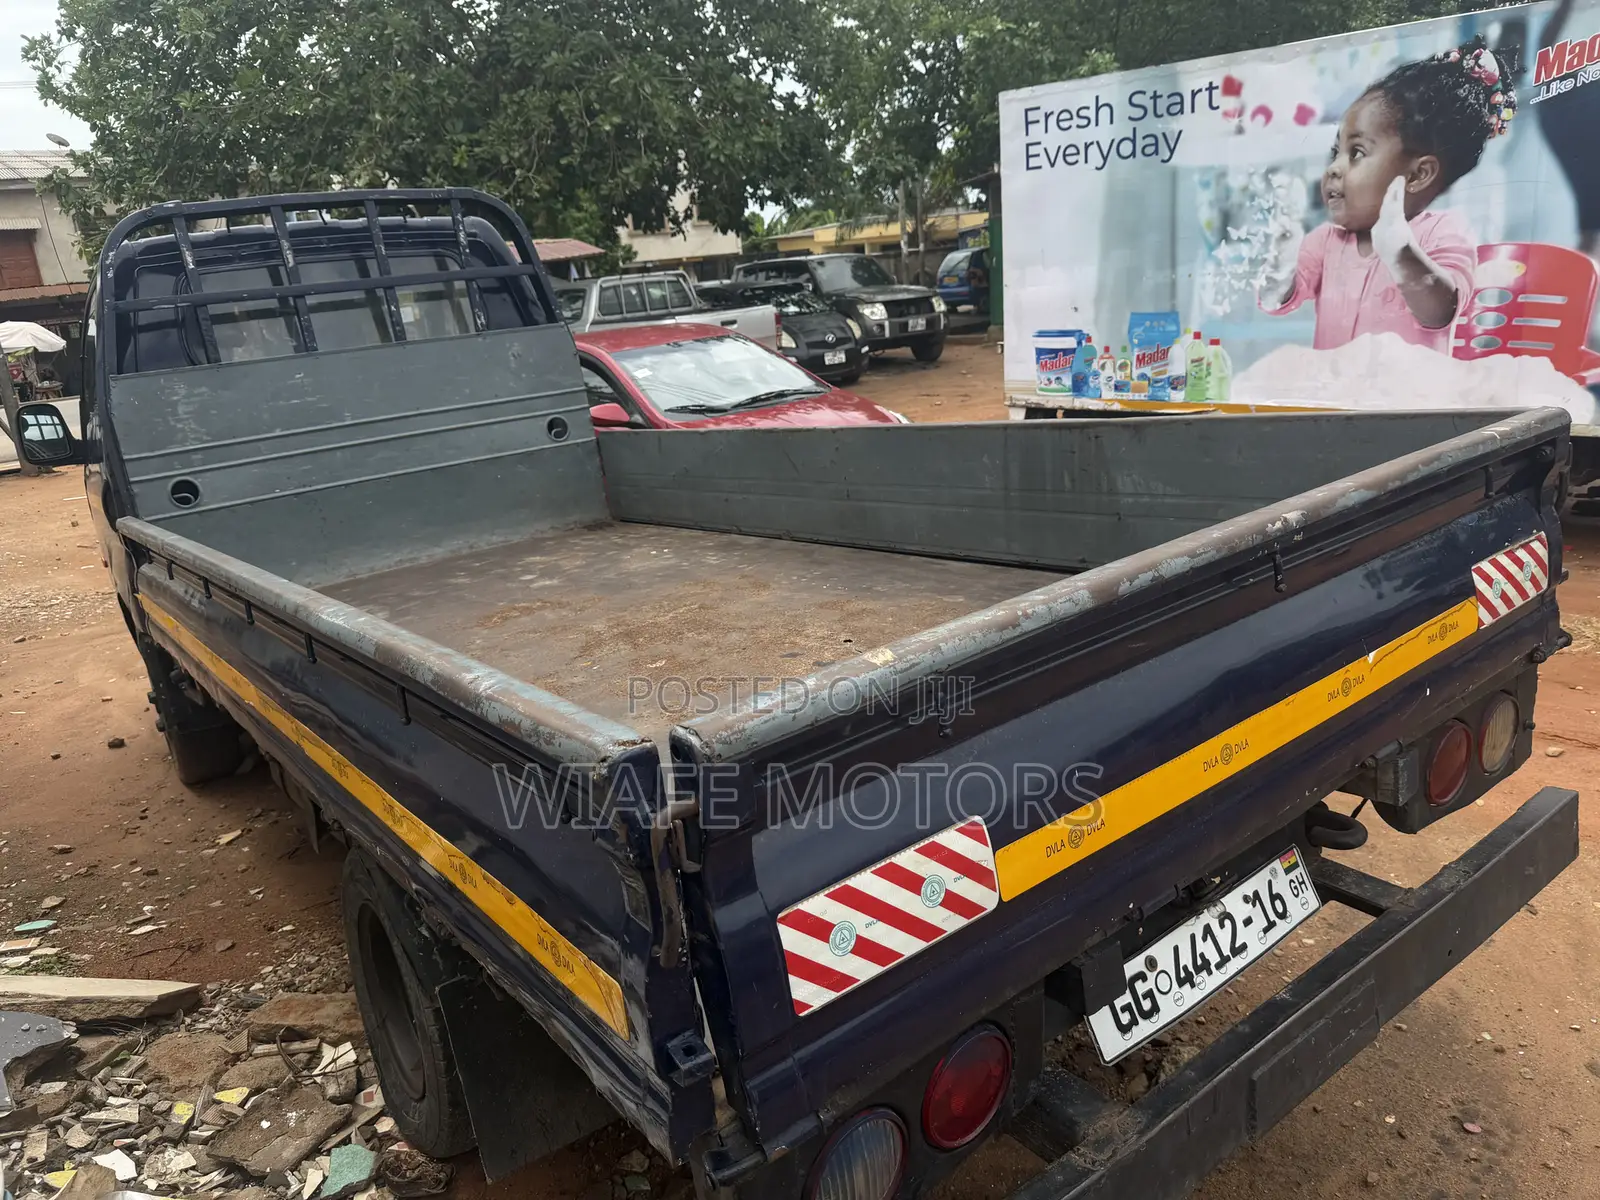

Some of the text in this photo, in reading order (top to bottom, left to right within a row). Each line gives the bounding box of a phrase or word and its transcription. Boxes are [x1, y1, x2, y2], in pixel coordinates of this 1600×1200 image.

[1024, 81, 1220, 137] Fresh Start
[1025, 127, 1183, 171] Everyday
[1040, 352, 1075, 373] Madar
[1328, 673, 1365, 702] DVLA DVLA
[1203, 738, 1249, 772] DVLA DVLA
[1045, 818, 1105, 858] DVLA DVLA
[1289, 872, 1308, 898] GH
[1173, 879, 1287, 989] 4412-16
